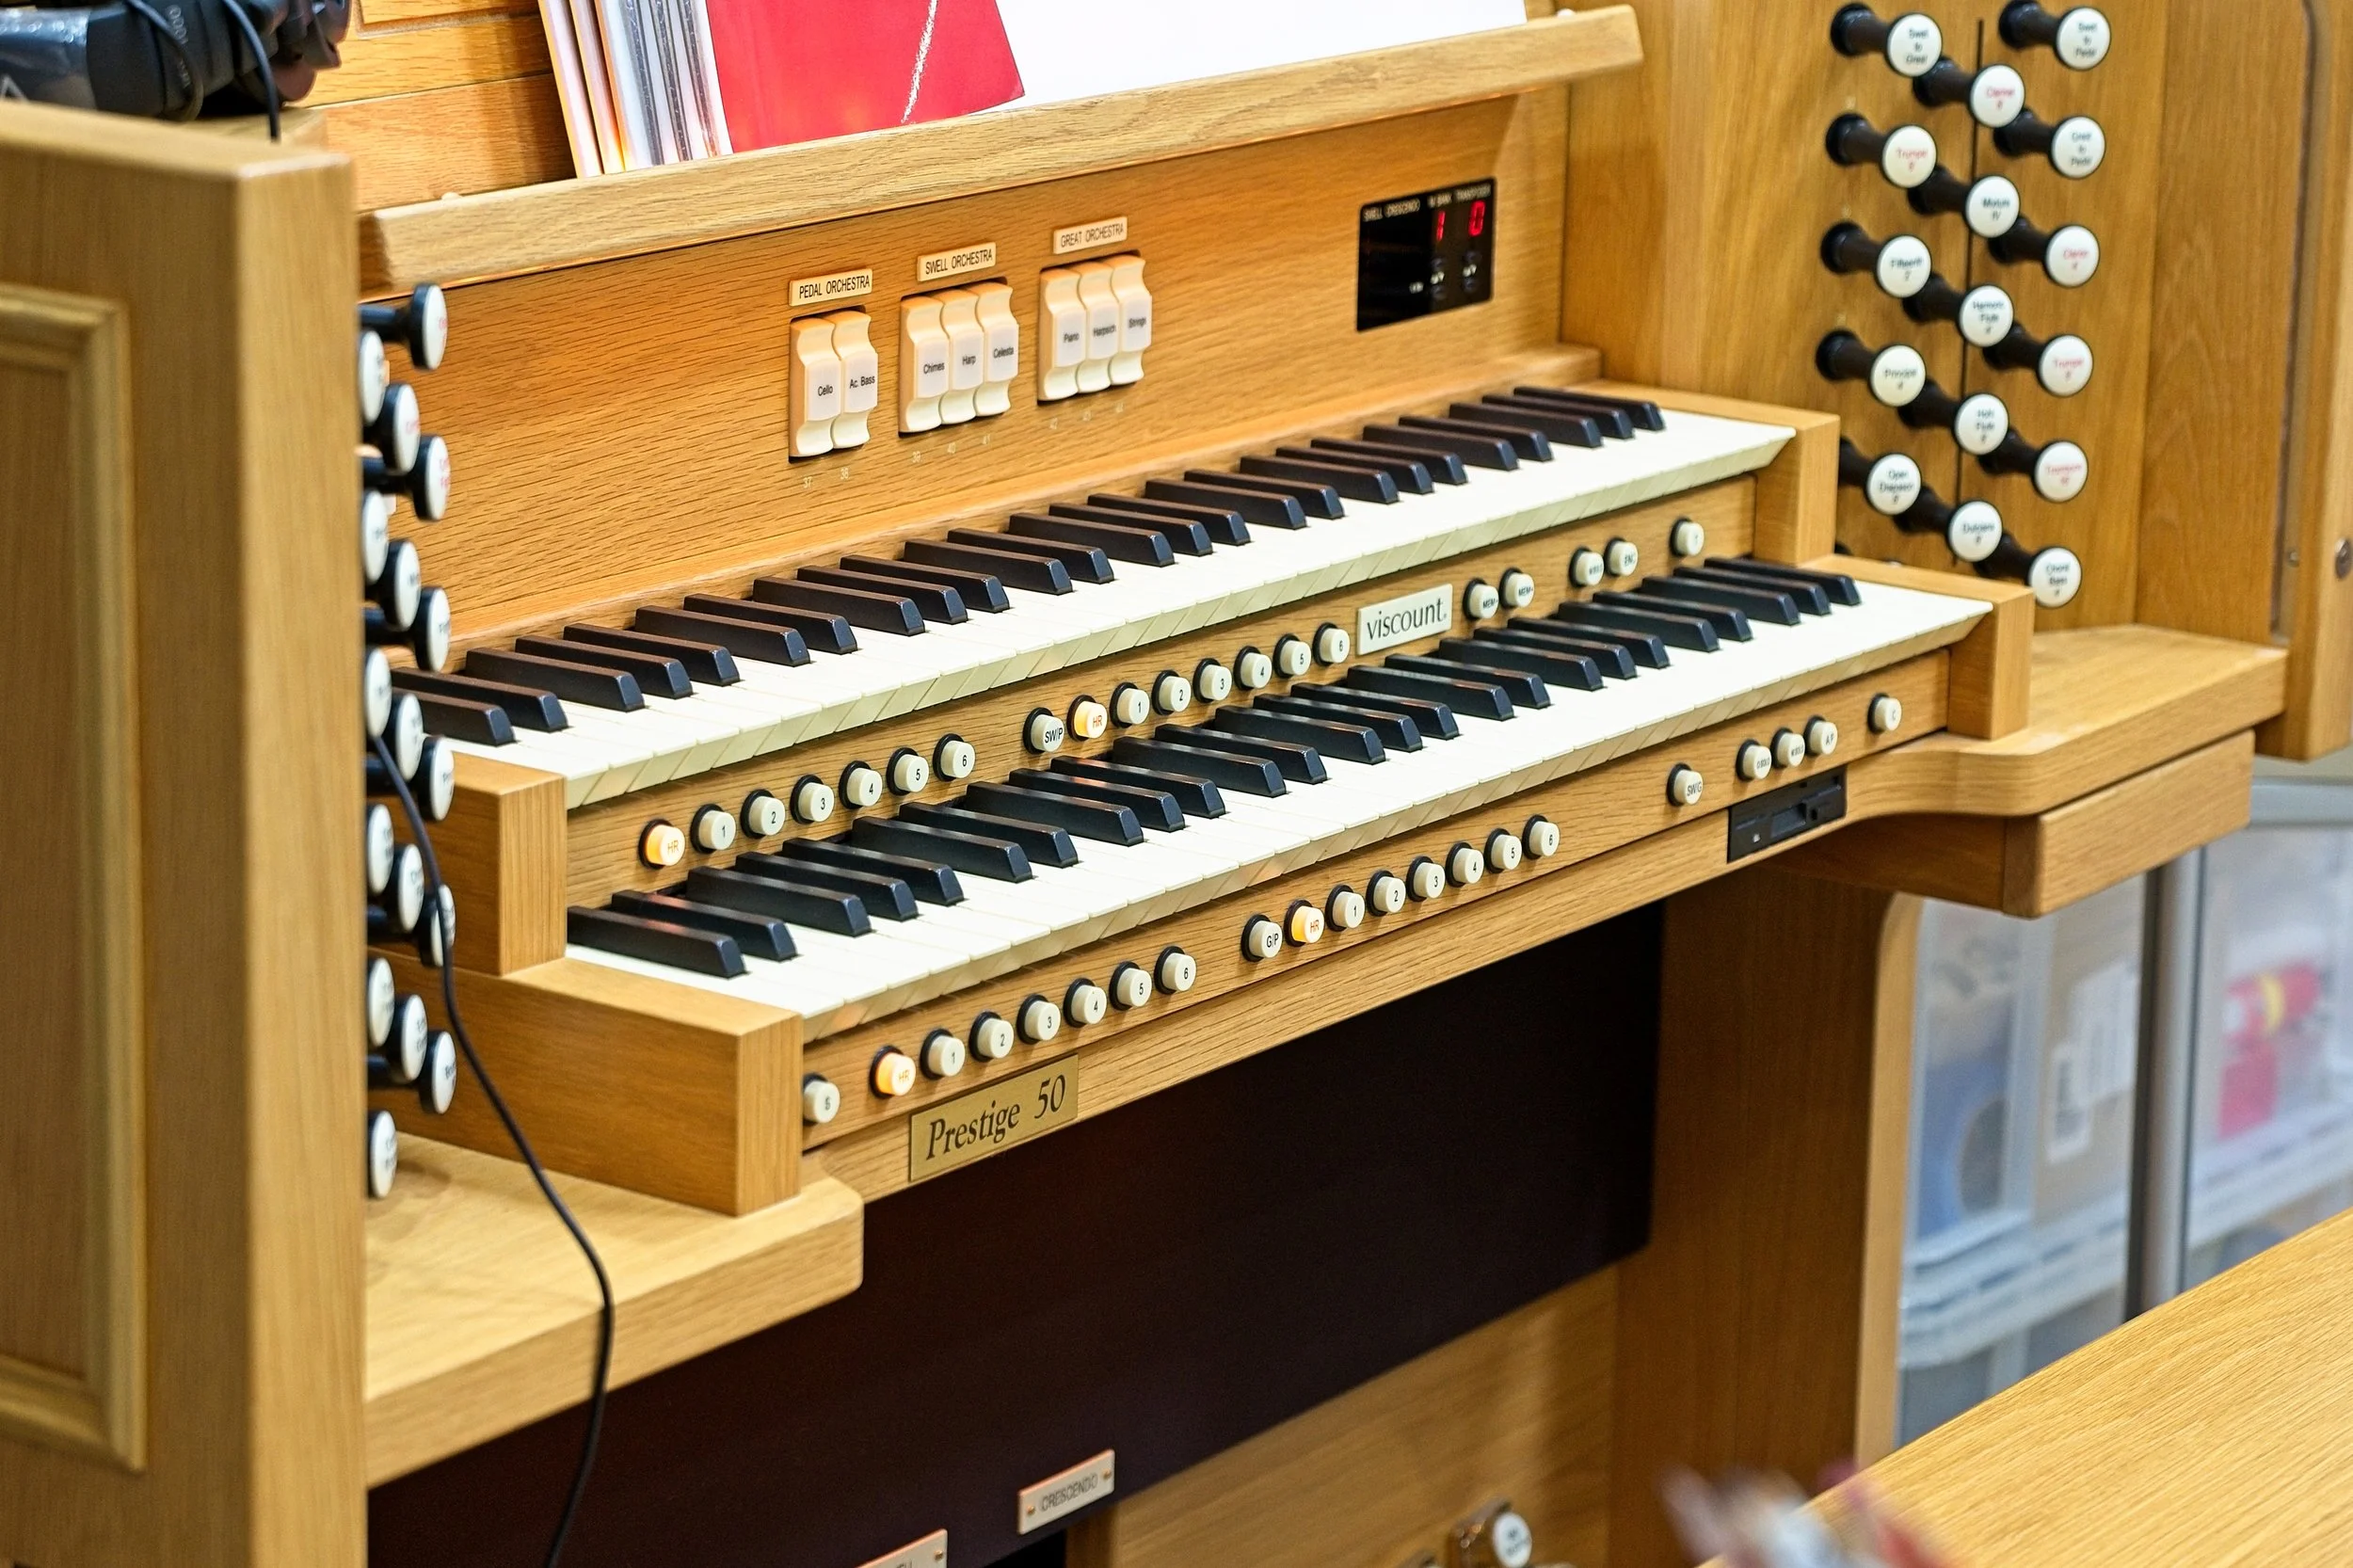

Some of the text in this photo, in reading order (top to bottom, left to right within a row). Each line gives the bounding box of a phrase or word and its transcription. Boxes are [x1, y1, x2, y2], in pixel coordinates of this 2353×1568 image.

[1468, 200, 1485, 237] 0
[1060, 222, 1125, 248] GREAT ORCHESTRA
[925, 248, 993, 275] SWELL ORCHESTRA
[799, 275, 871, 299] PEDAL ORCHESTRA
[962, 356, 977, 366] Harp
[923, 362, 945, 375] Chimes
[849, 375, 876, 390] Ac. Bass
[817, 384, 834, 397] Cello
[1367, 597, 1444, 640] viscount
[1338, 640, 1344, 651] 6
[1299, 653, 1305, 664] 5
[1259, 666, 1265, 678] 4
[1220, 678, 1225, 691] 3
[1178, 689, 1184, 702] 2
[1137, 702, 1143, 713] 1
[1093, 715, 1103, 728] HR
[962, 755, 968, 766] 6
[915, 768, 920, 781] 5
[868, 783, 873, 794] 4
[821, 798, 826, 809] 3
[771, 811, 776, 823] 2
[721, 825, 727, 838] 1
[1547, 834, 1553, 846] 6
[667, 840, 679, 855] HR
[1510, 847, 1515, 859] 5
[1472, 862, 1478, 873] 4
[1433, 875, 1439, 888] 3
[1393, 890, 1399, 902] 2
[1353, 905, 1357, 917] 1
[1309, 920, 1320, 934] HR
[1183, 968, 1189, 980] 6
[1139, 983, 1144, 996] 5
[1094, 1001, 1099, 1013] 4
[1047, 1016, 1052, 1029] 3
[1000, 1034, 1005, 1047] 2
[951, 1052, 956, 1064] 1
[926, 1074, 1066, 1160] Prestige 50
[1041, 1473, 1098, 1511] CRESCENDO
